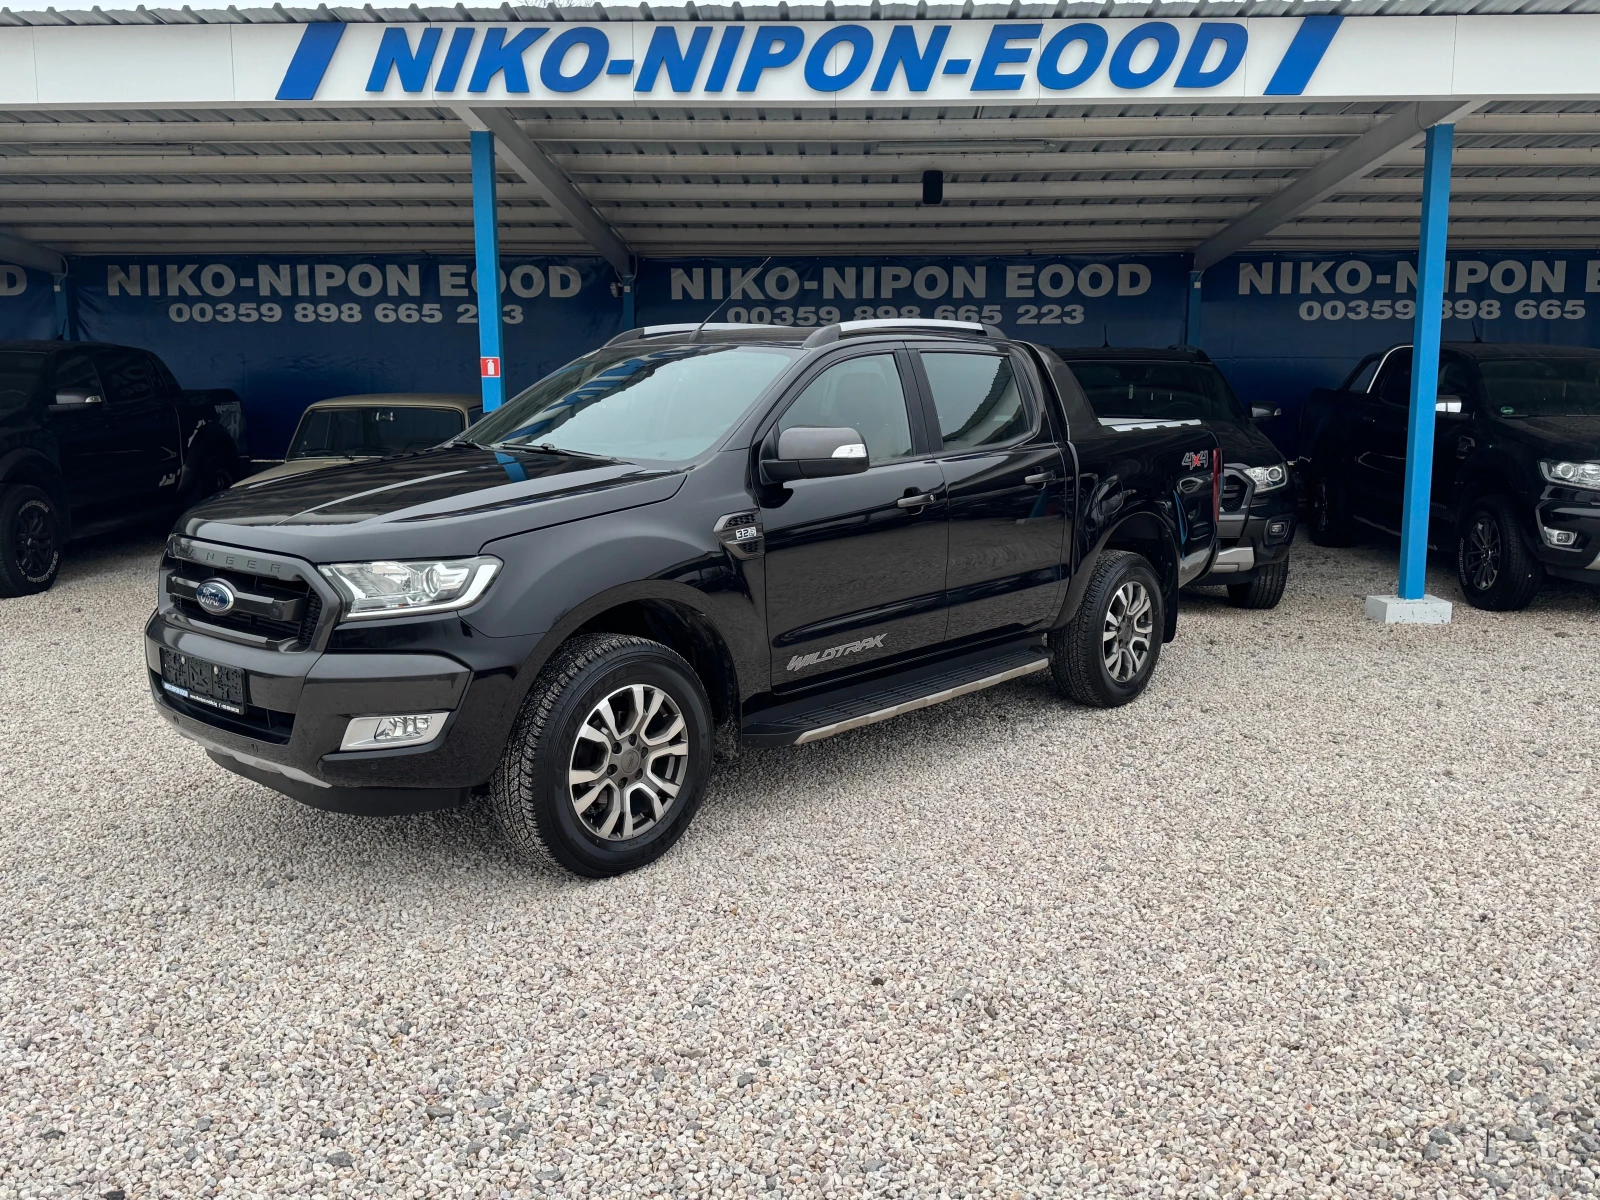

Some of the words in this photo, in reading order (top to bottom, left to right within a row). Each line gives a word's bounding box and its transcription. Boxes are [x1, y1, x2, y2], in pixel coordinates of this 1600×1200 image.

[365, 22, 1249, 93] NIKO-NIPON-EOOD
[107, 264, 421, 297] NIKO-NIPON
[671, 265, 986, 300] NIKO-NIPON
[1005, 263, 1151, 298] EOOD
[168, 303, 282, 323] 00359
[294, 303, 363, 323] 898
[374, 303, 443, 324] 665
[456, 304, 524, 325] 23
[726, 306, 841, 326] 00359
[934, 304, 1003, 325] 665
[1016, 304, 1085, 325] 223
[1299, 300, 1416, 321] 00359
[1515, 299, 1586, 320] 665
[786, 632, 889, 671] WILDTRAK
